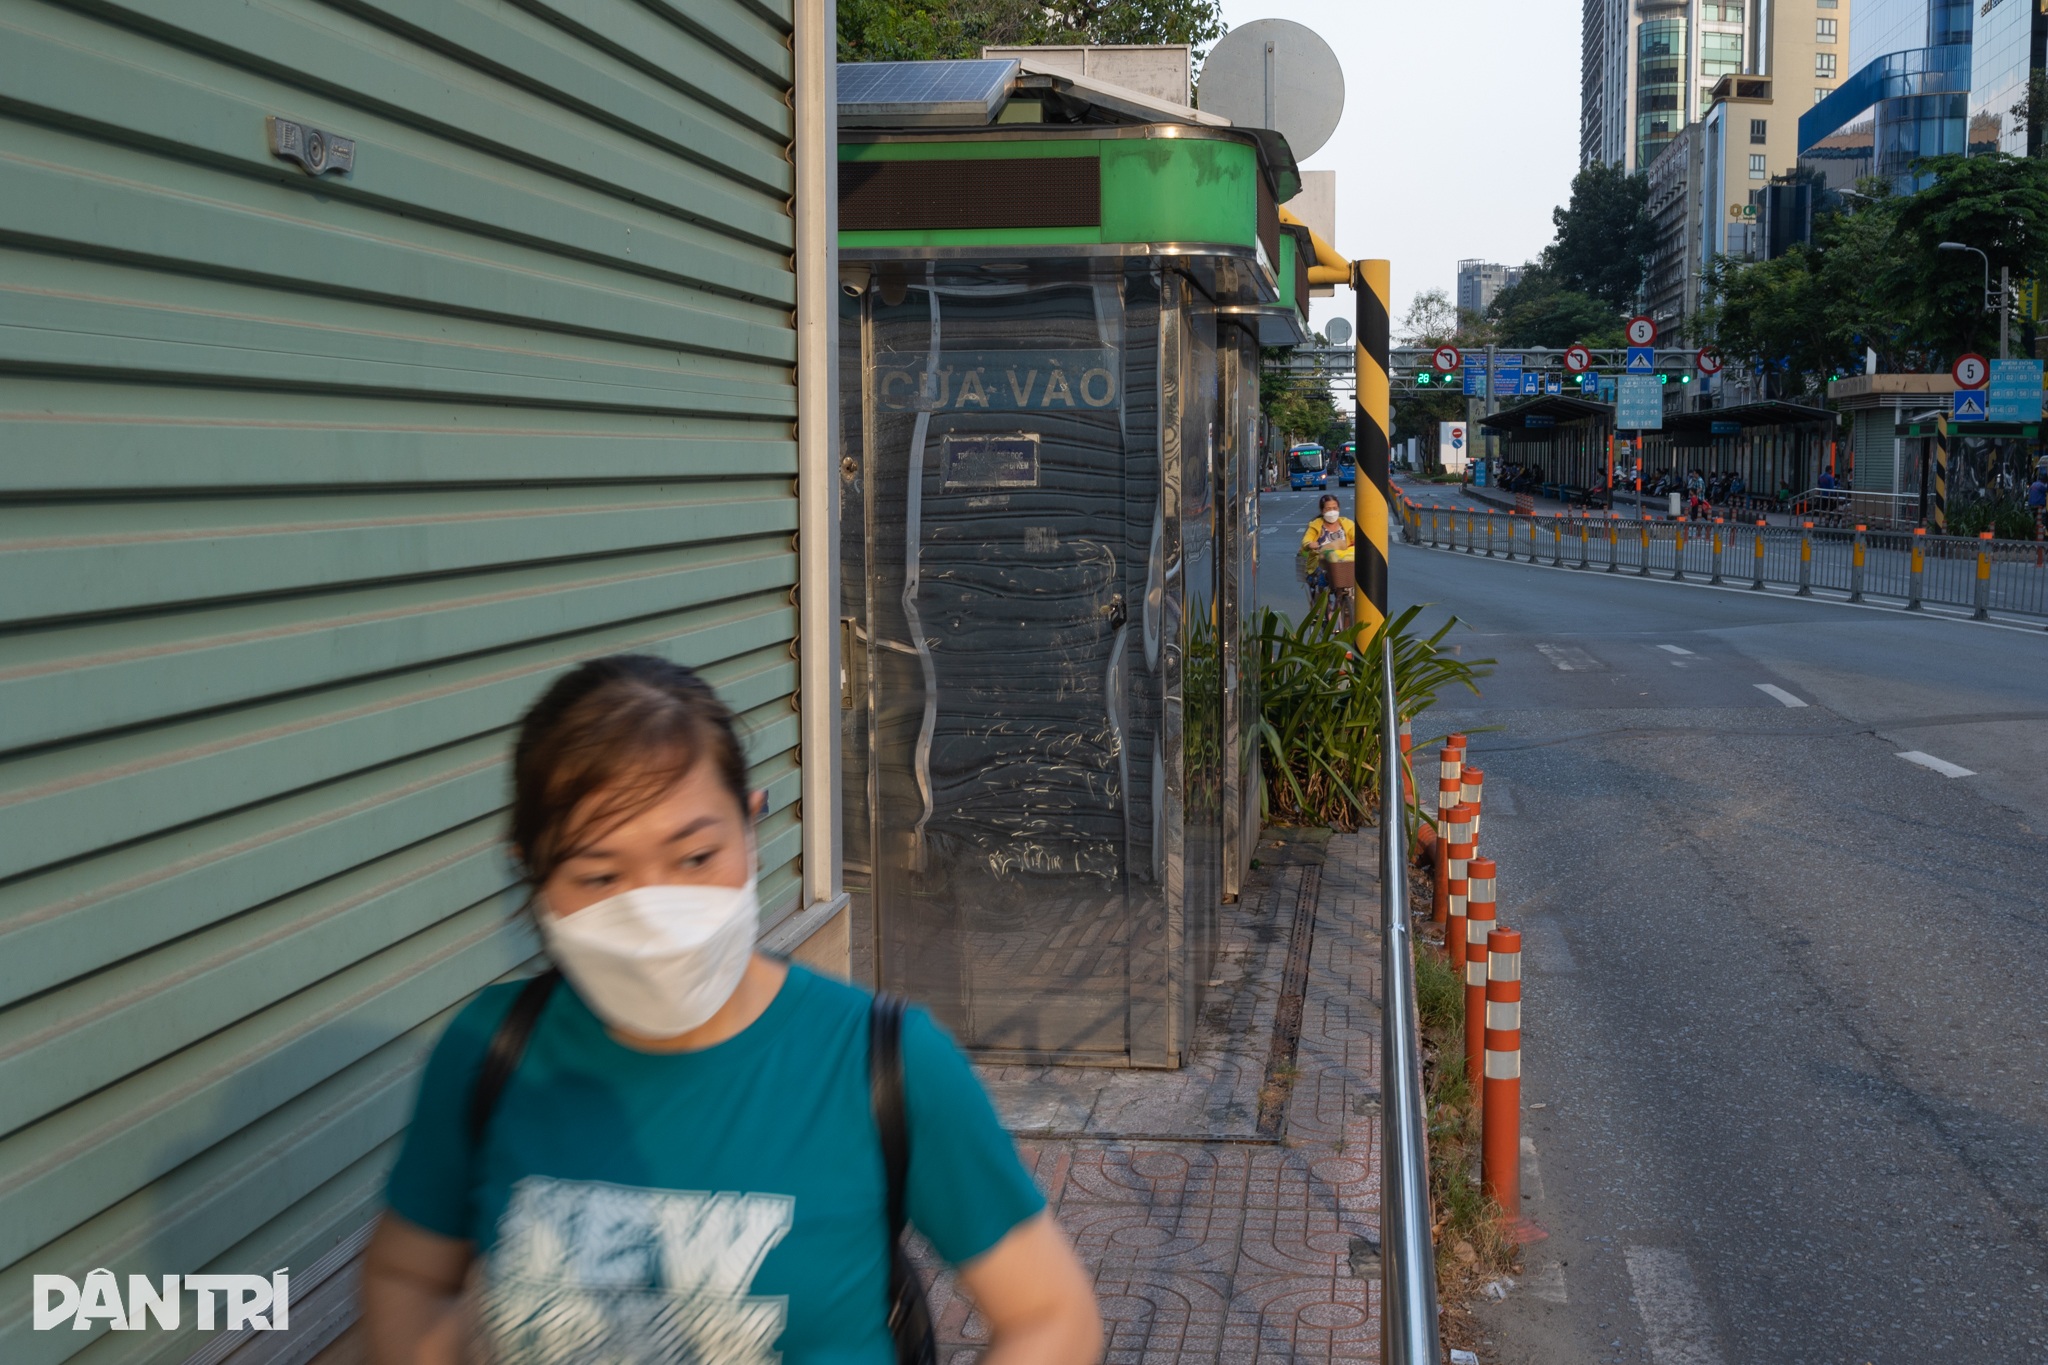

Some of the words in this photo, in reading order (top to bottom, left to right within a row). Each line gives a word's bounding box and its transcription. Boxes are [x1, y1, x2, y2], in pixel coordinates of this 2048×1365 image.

[1638, 325, 1645, 338] 5
[1966, 363, 1975, 379] 5
[1006, 359, 1117, 407] VÀO
[1417, 373, 1430, 384] 28
